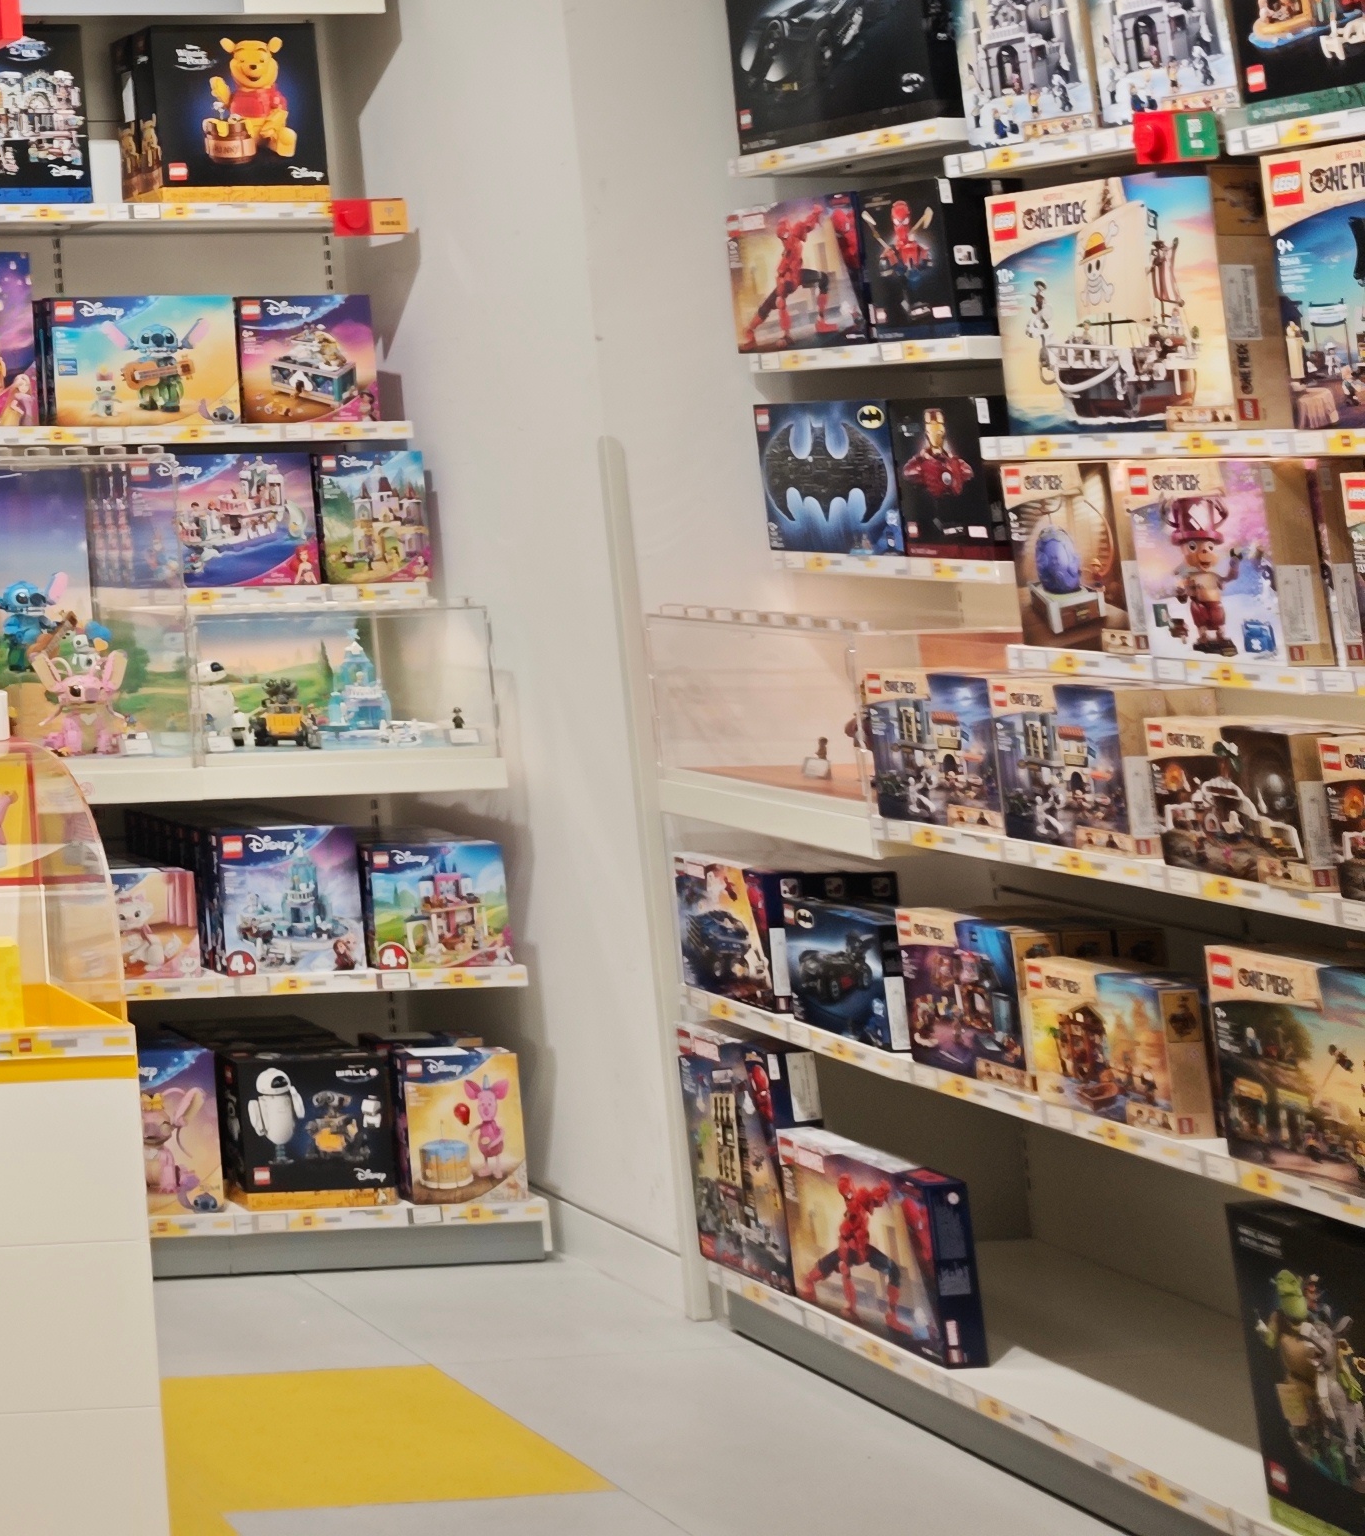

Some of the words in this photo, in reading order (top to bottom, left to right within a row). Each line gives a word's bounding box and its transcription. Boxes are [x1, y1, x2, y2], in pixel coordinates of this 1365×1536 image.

[1271, 172, 1301, 196] LEGO
[1309, 164, 1348, 194] ONE
[1022, 205, 1052, 231] ONE
[1054, 200, 1088, 228] PIECE
